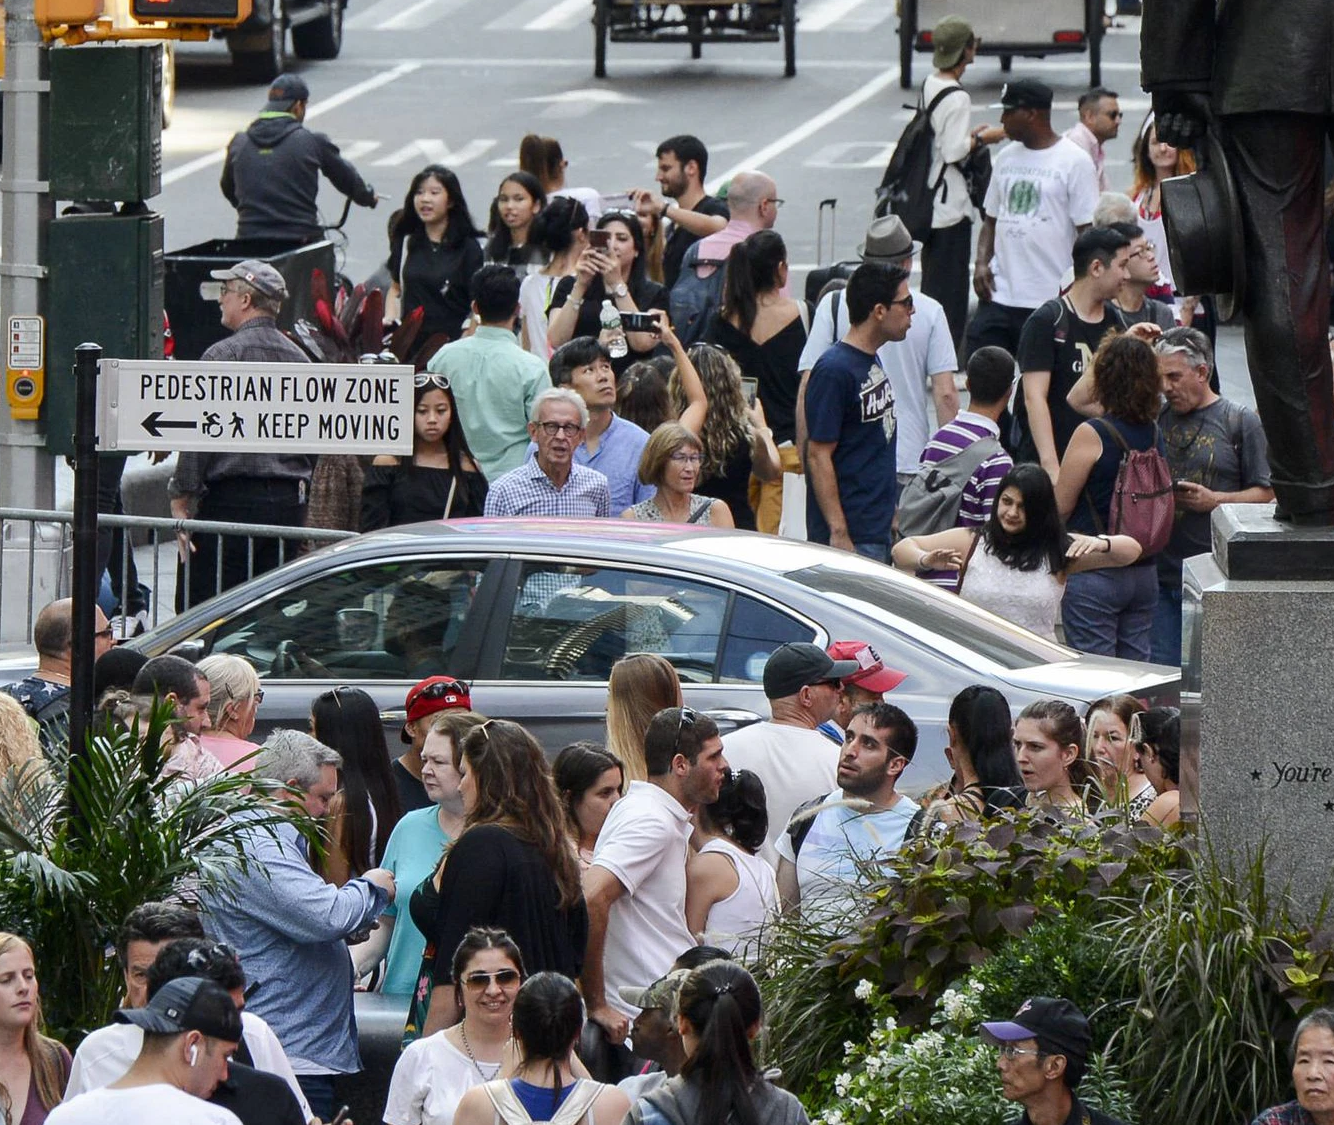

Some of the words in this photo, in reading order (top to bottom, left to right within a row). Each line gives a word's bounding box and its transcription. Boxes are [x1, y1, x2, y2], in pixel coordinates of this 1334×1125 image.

[140, 374, 272, 402] PEDESTRIAN
[280, 376, 337, 403] FLOW
[345, 377, 400, 404] ZONE
[257, 412, 310, 439] KEEP
[318, 413, 400, 441] MOVING
[1270, 761, 1333, 789] You're
